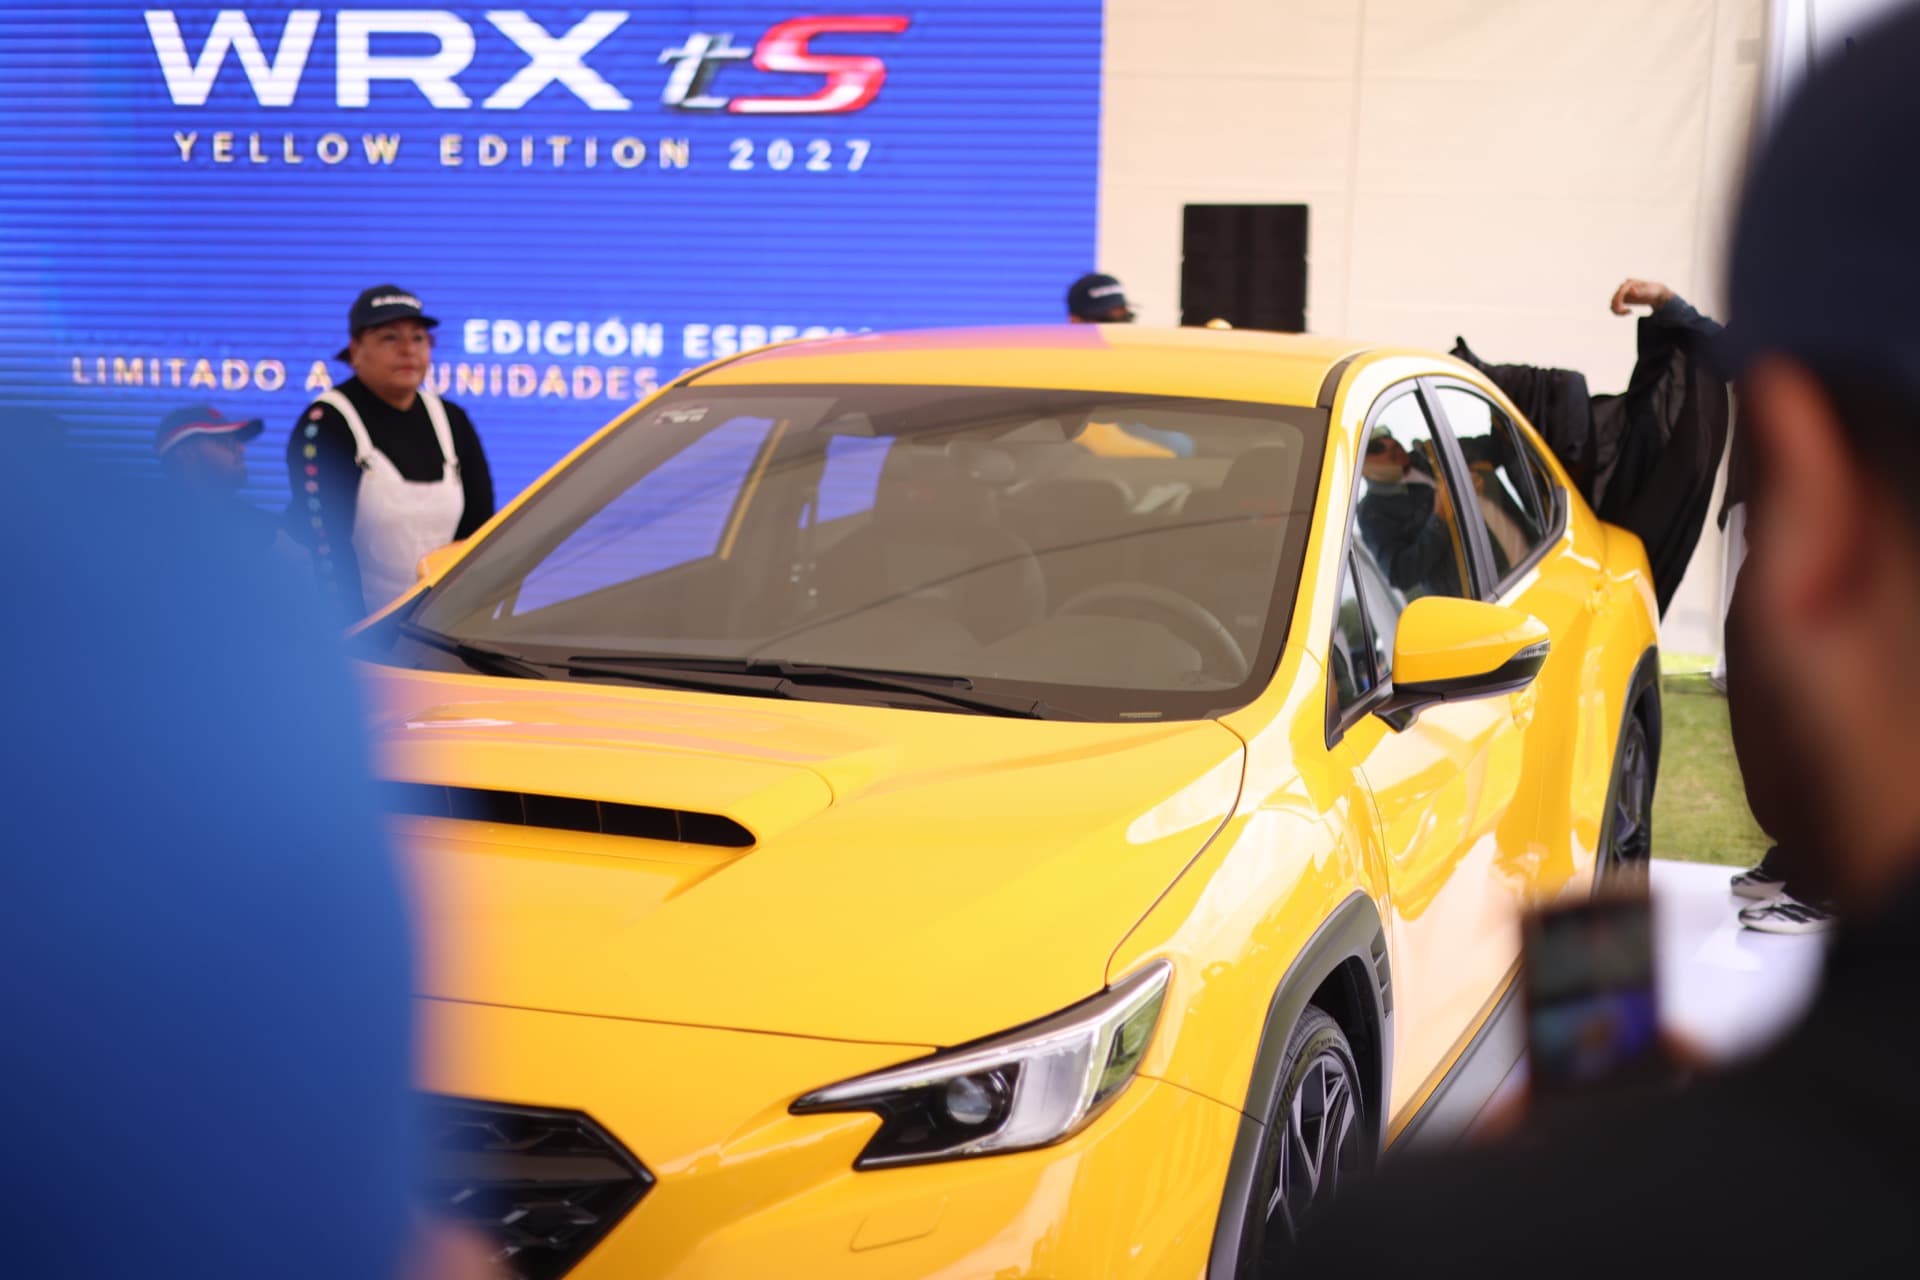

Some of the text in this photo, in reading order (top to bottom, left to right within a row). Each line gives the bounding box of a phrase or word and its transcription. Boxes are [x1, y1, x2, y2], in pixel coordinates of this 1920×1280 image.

[144, 9, 910, 115] WRX tS
[173, 131, 872, 172] YELLOW EDITION 2027
[463, 316, 664, 358] EDICIÓN
[71, 356, 660, 401] LIMITADO A UNIDADES
